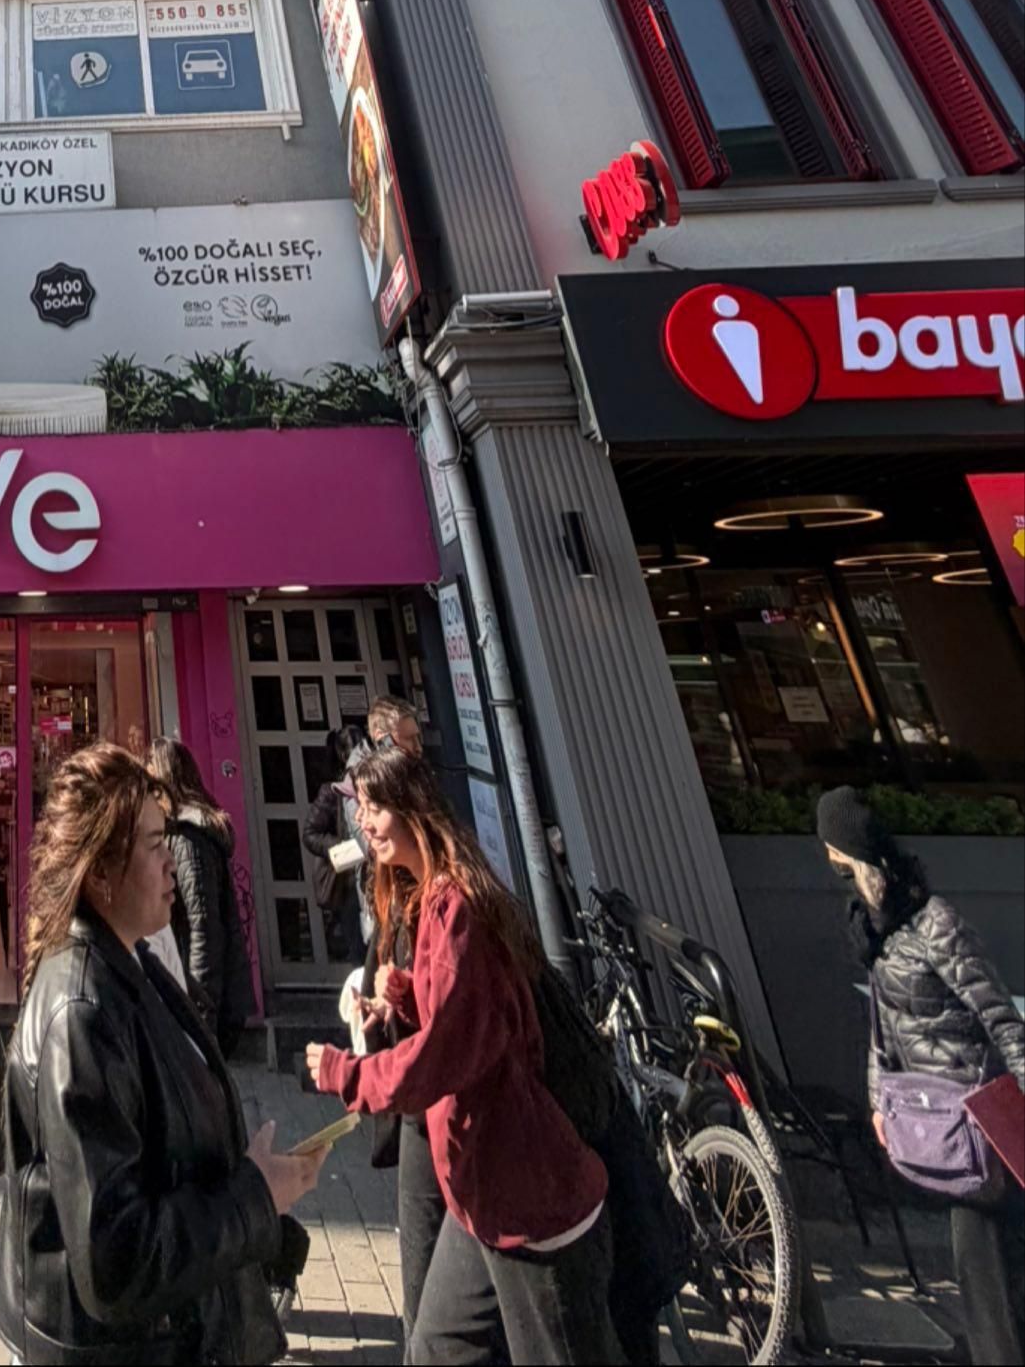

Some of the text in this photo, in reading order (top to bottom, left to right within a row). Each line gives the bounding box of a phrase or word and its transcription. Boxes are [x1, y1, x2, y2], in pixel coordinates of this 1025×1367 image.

[156, 6, 187, 21] 550
[197, 4, 207, 19] 0
[216, 2, 249, 18] 855
[0, 139, 59, 152] KADIKÖY
[62, 137, 98, 150] ÖZEL
[24, 183, 106, 204] KURSU
[138, 238, 322, 262] %100 DOĞALI SEÇ,
[154, 263, 313, 286] ÖZGÜR HİSSET!
[42, 280, 82, 296] %100
[43, 295, 85, 311] DOĞAL
[835, 286, 1025, 401] bay
